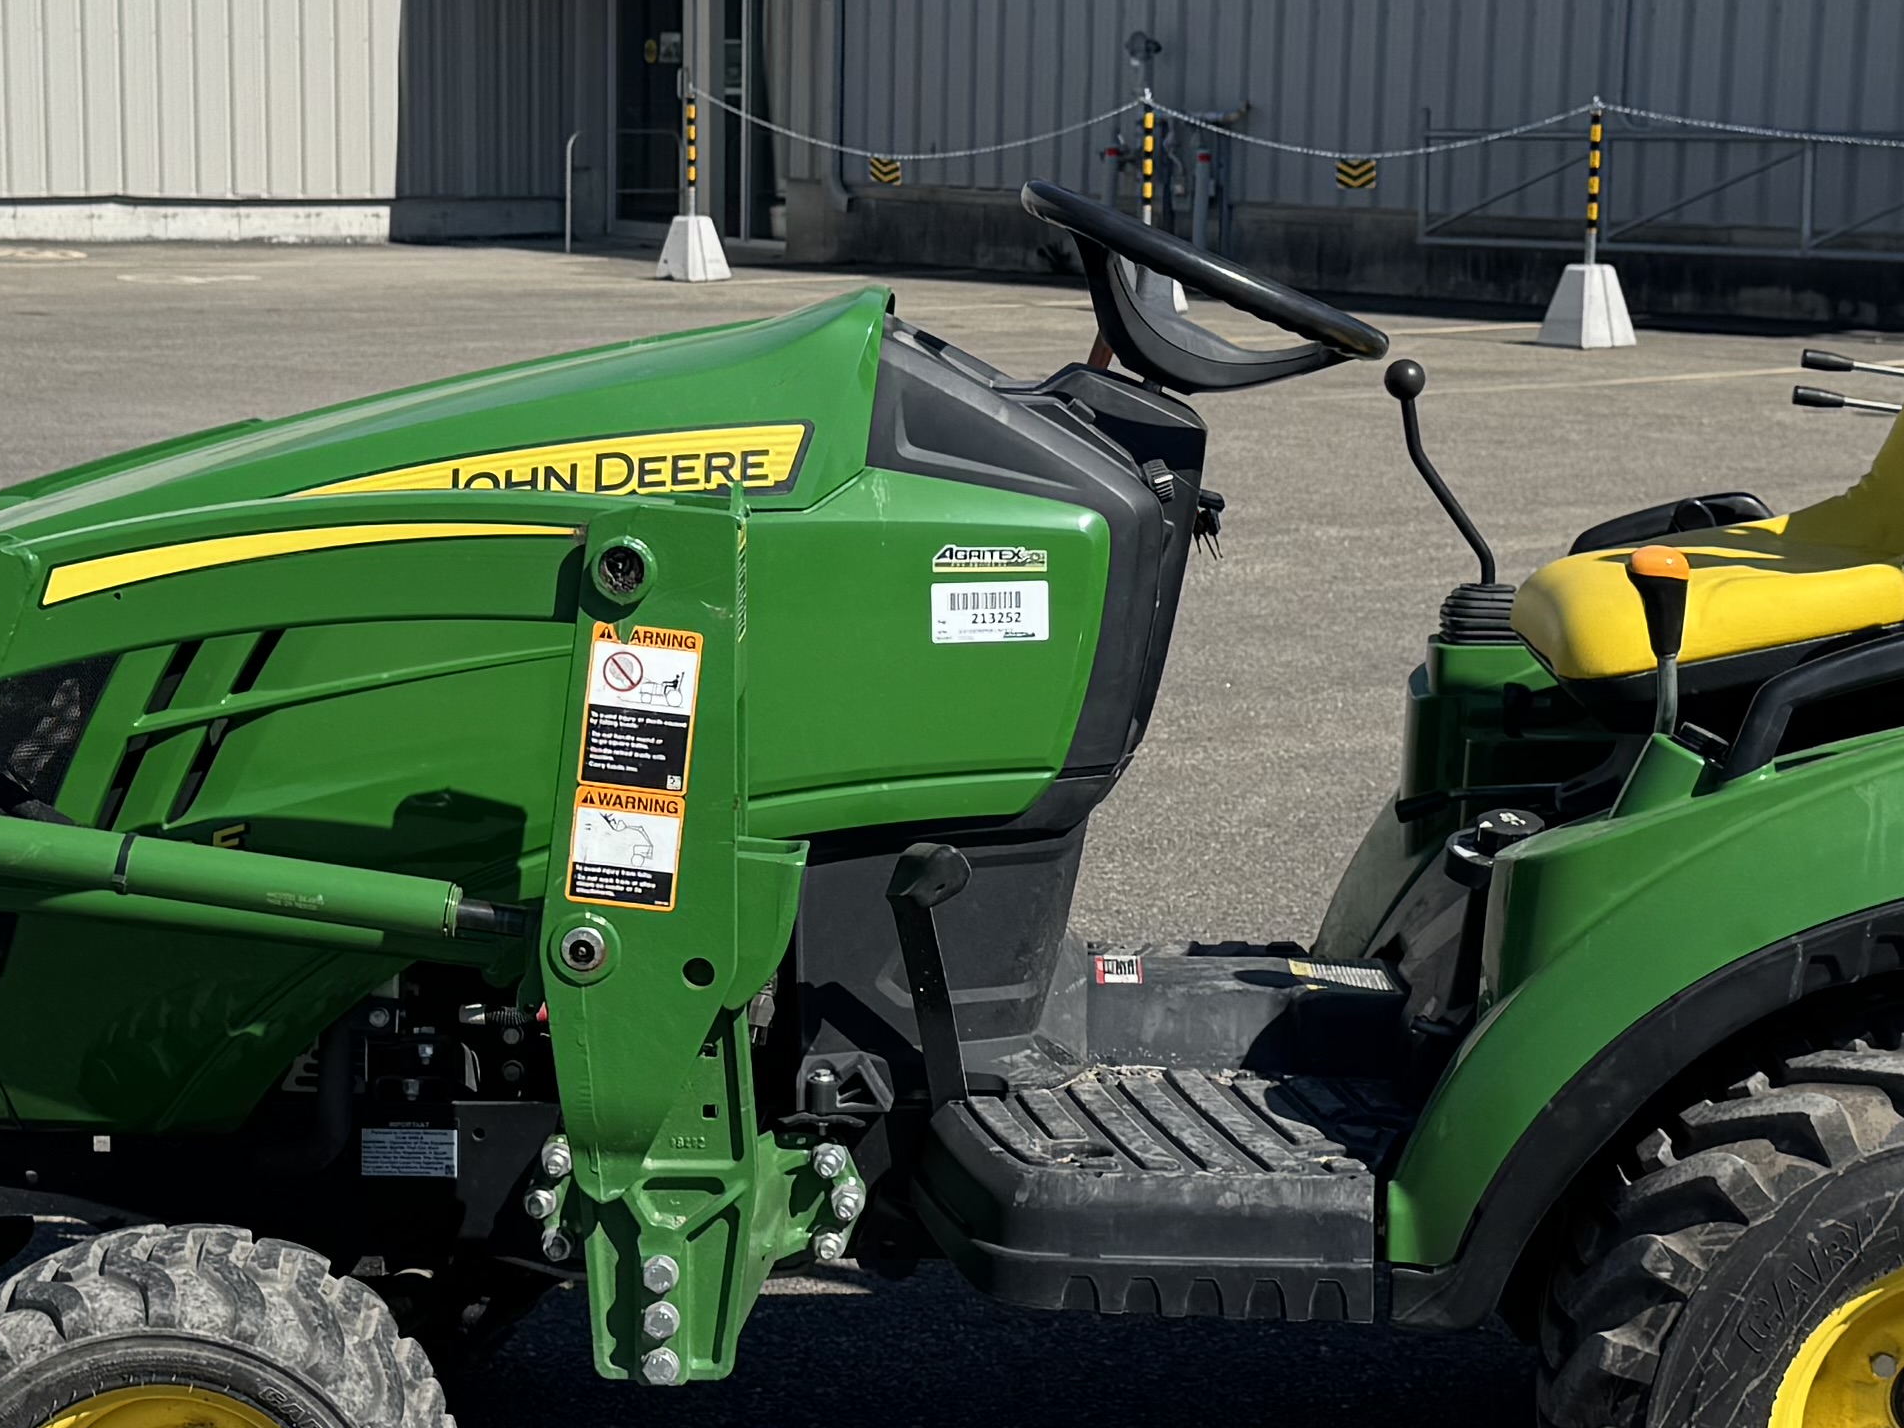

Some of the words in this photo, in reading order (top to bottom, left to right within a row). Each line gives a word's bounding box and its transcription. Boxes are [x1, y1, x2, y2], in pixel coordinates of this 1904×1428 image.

[451, 462, 579, 491] JOHN
[594, 448, 770, 493] DEERE
[936, 547, 1021, 561] AGRITEX
[971, 612, 1022, 624] 213252
[630, 629, 697, 650] ARNING
[598, 792, 679, 814] WARNING
